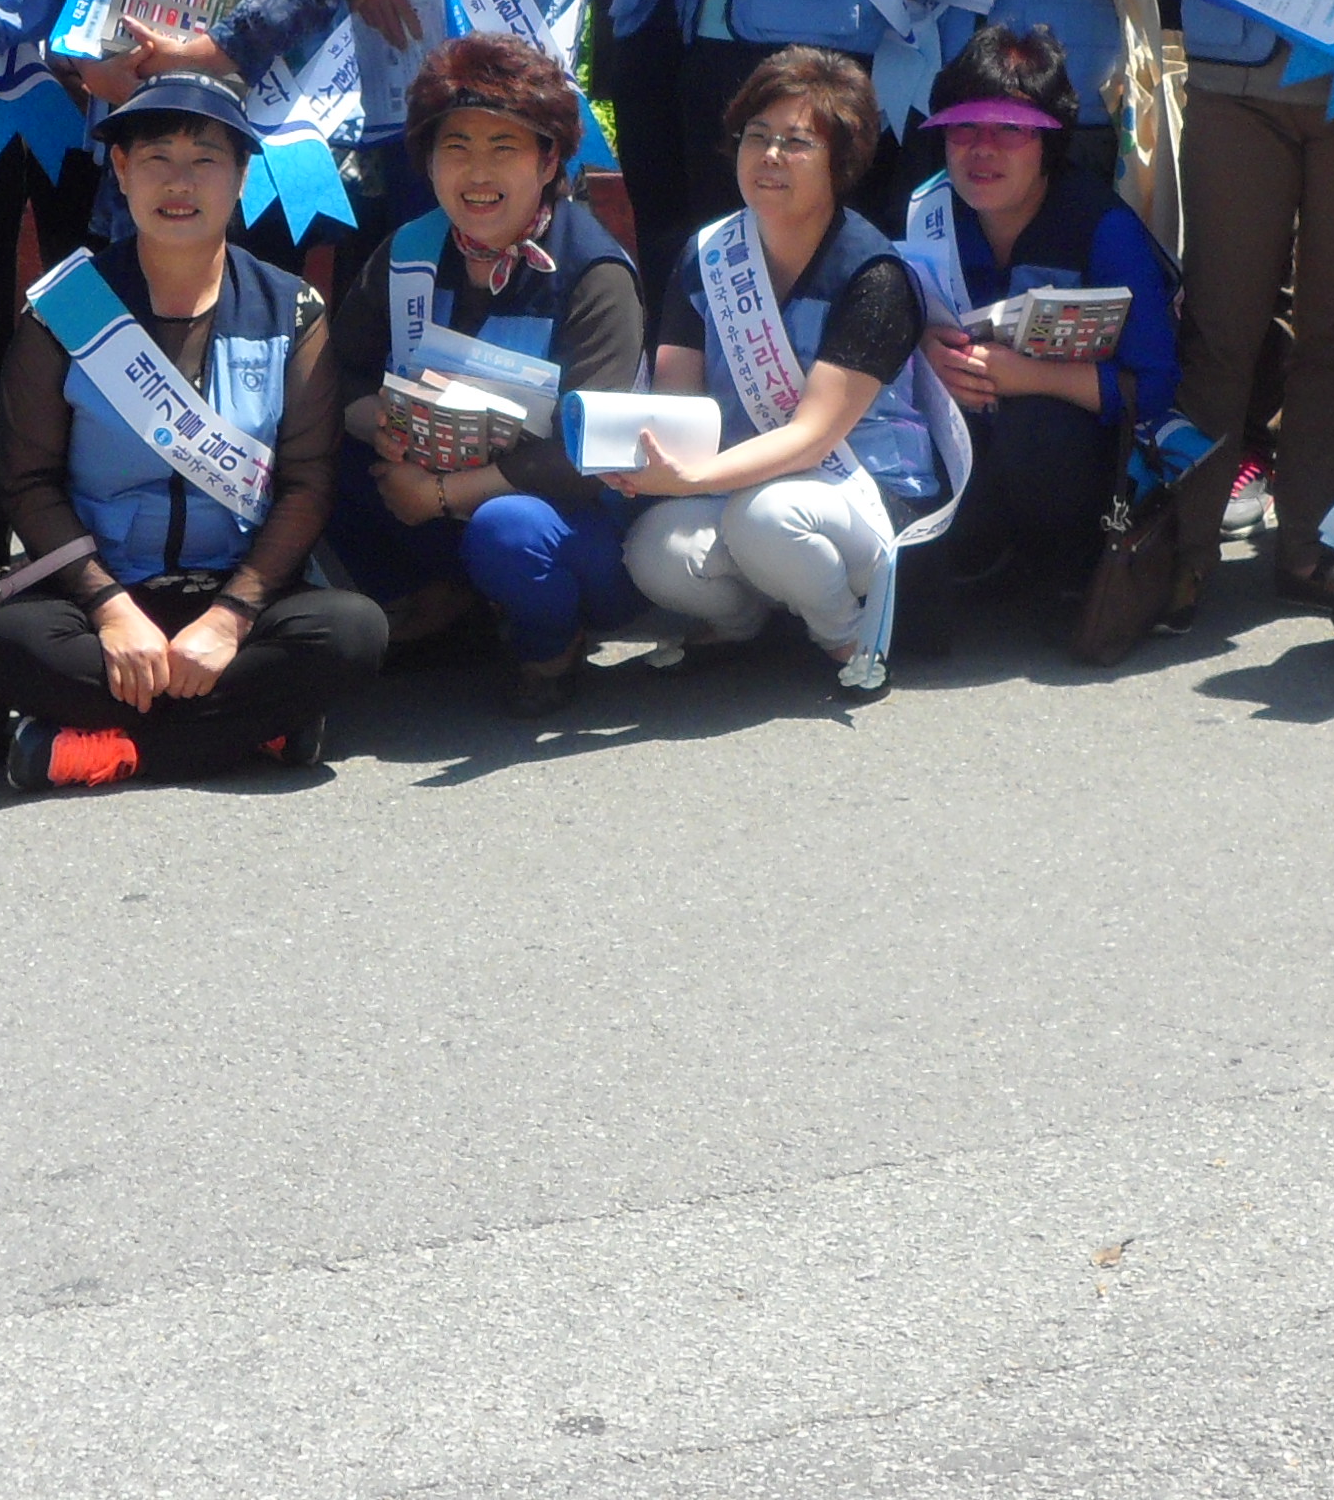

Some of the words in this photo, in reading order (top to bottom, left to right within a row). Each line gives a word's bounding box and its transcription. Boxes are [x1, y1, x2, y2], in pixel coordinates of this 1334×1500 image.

[730, 266, 763, 315] 달아
[124, 351, 207, 441] 태극기를
[197, 431, 248, 473] 달아
